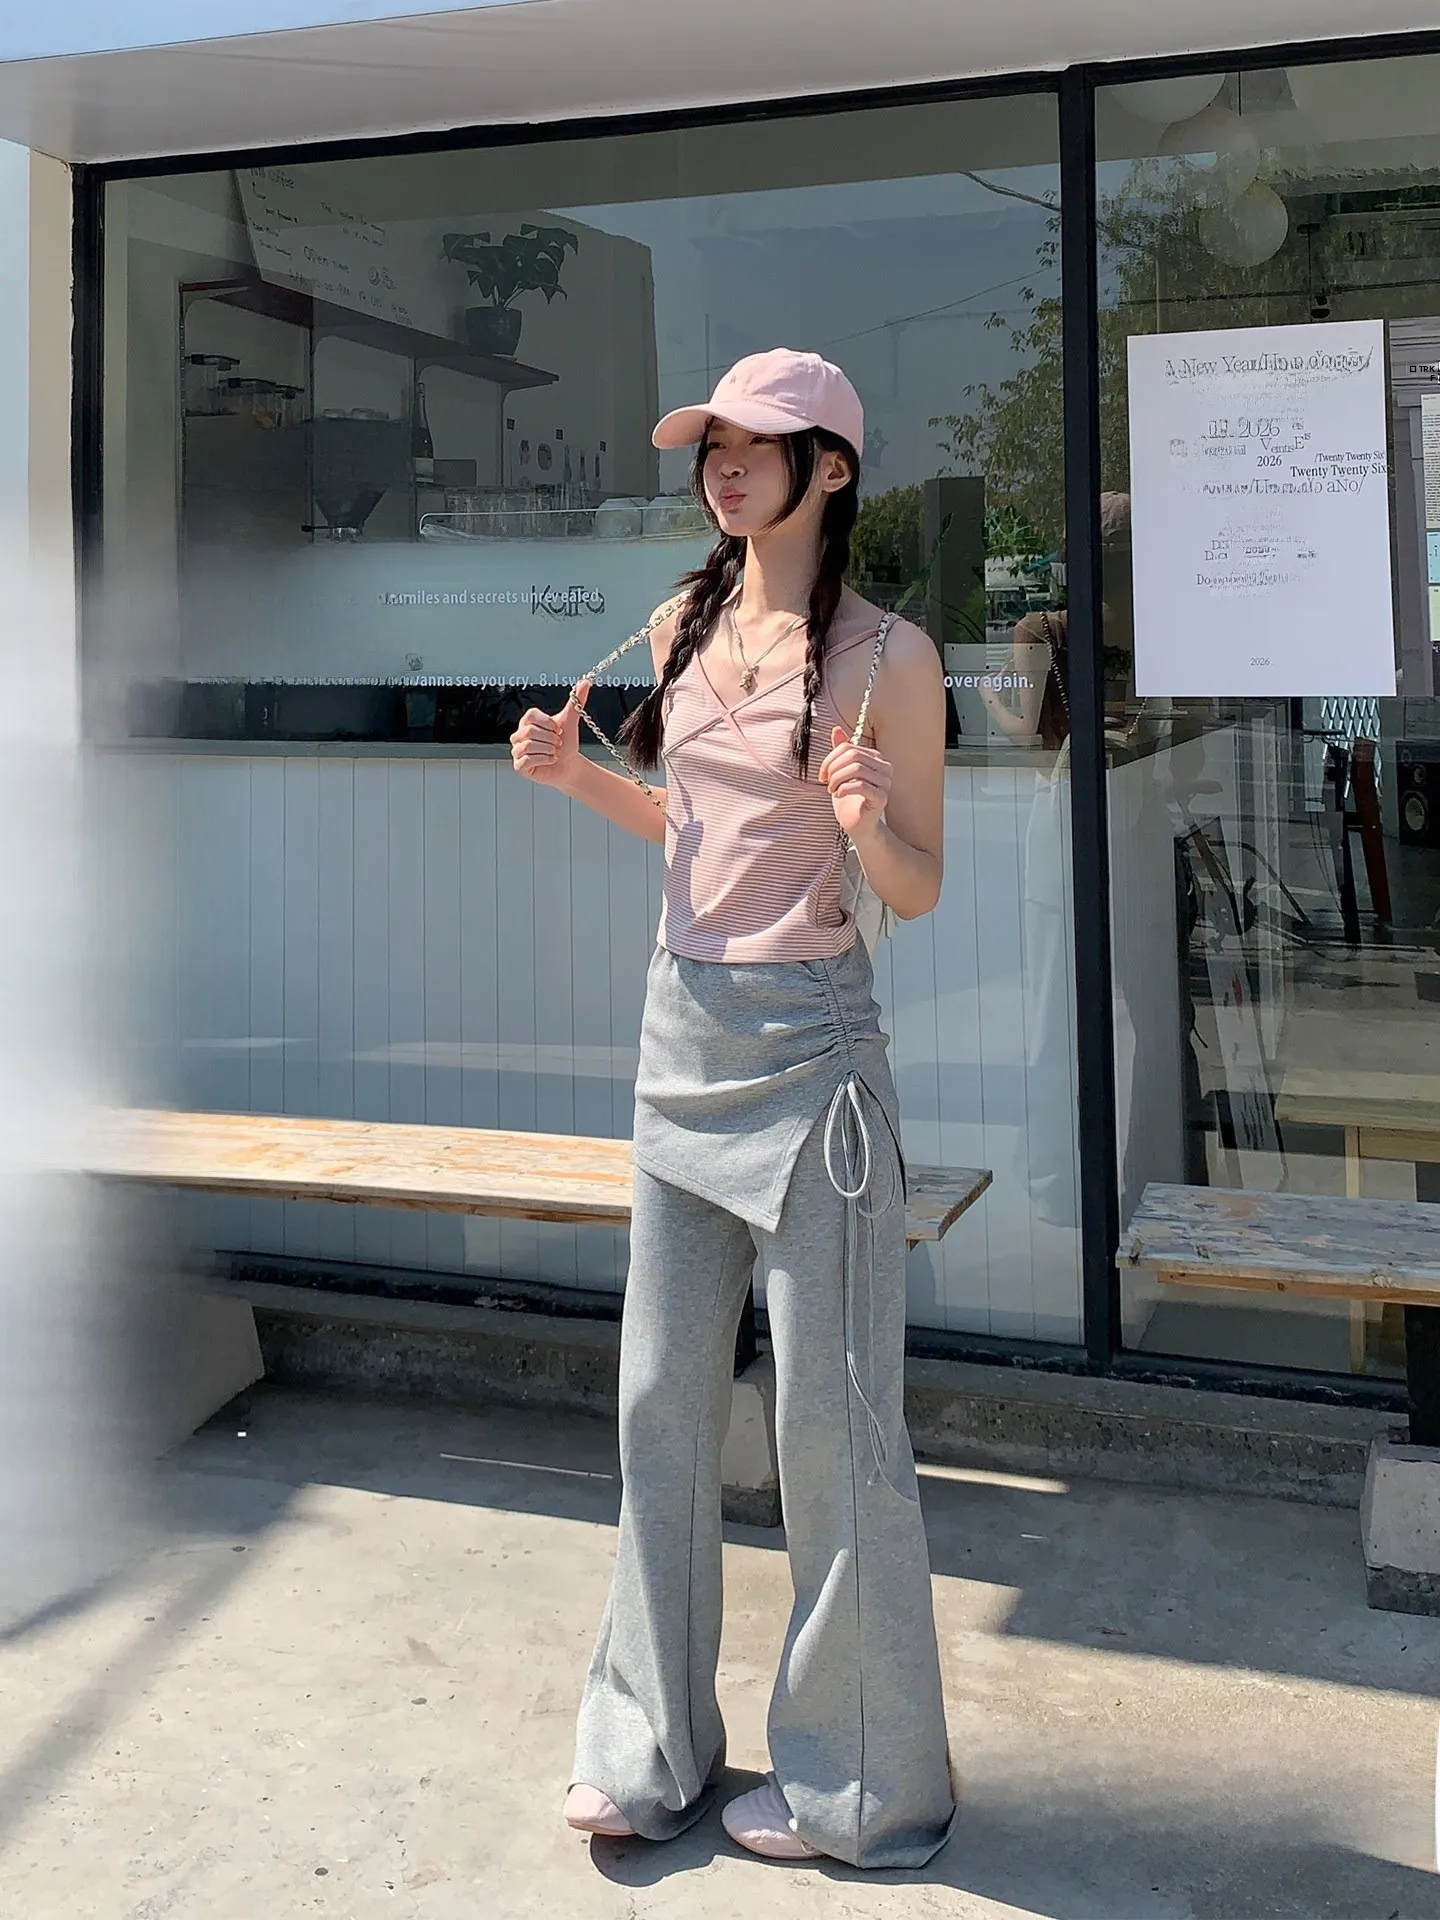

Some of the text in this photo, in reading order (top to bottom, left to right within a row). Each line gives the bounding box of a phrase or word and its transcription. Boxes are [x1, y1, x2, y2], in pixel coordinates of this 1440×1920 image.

[1256, 455, 1283, 467] 2026
[1290, 463, 1387, 479] Twenty Twenty Six
[442, 589, 467, 604] and
[470, 590, 518, 604] secrets
[1250, 657, 1271, 665] 2026
[455, 675, 478, 687] see
[480, 675, 505, 690] you
[508, 675, 534, 690] cry.
[539, 673, 552, 687] 8.
[606, 674, 619, 687] to
[623, 675, 650, 690] you
[943, 675, 978, 688] over
[983, 672, 1034, 691] again.
